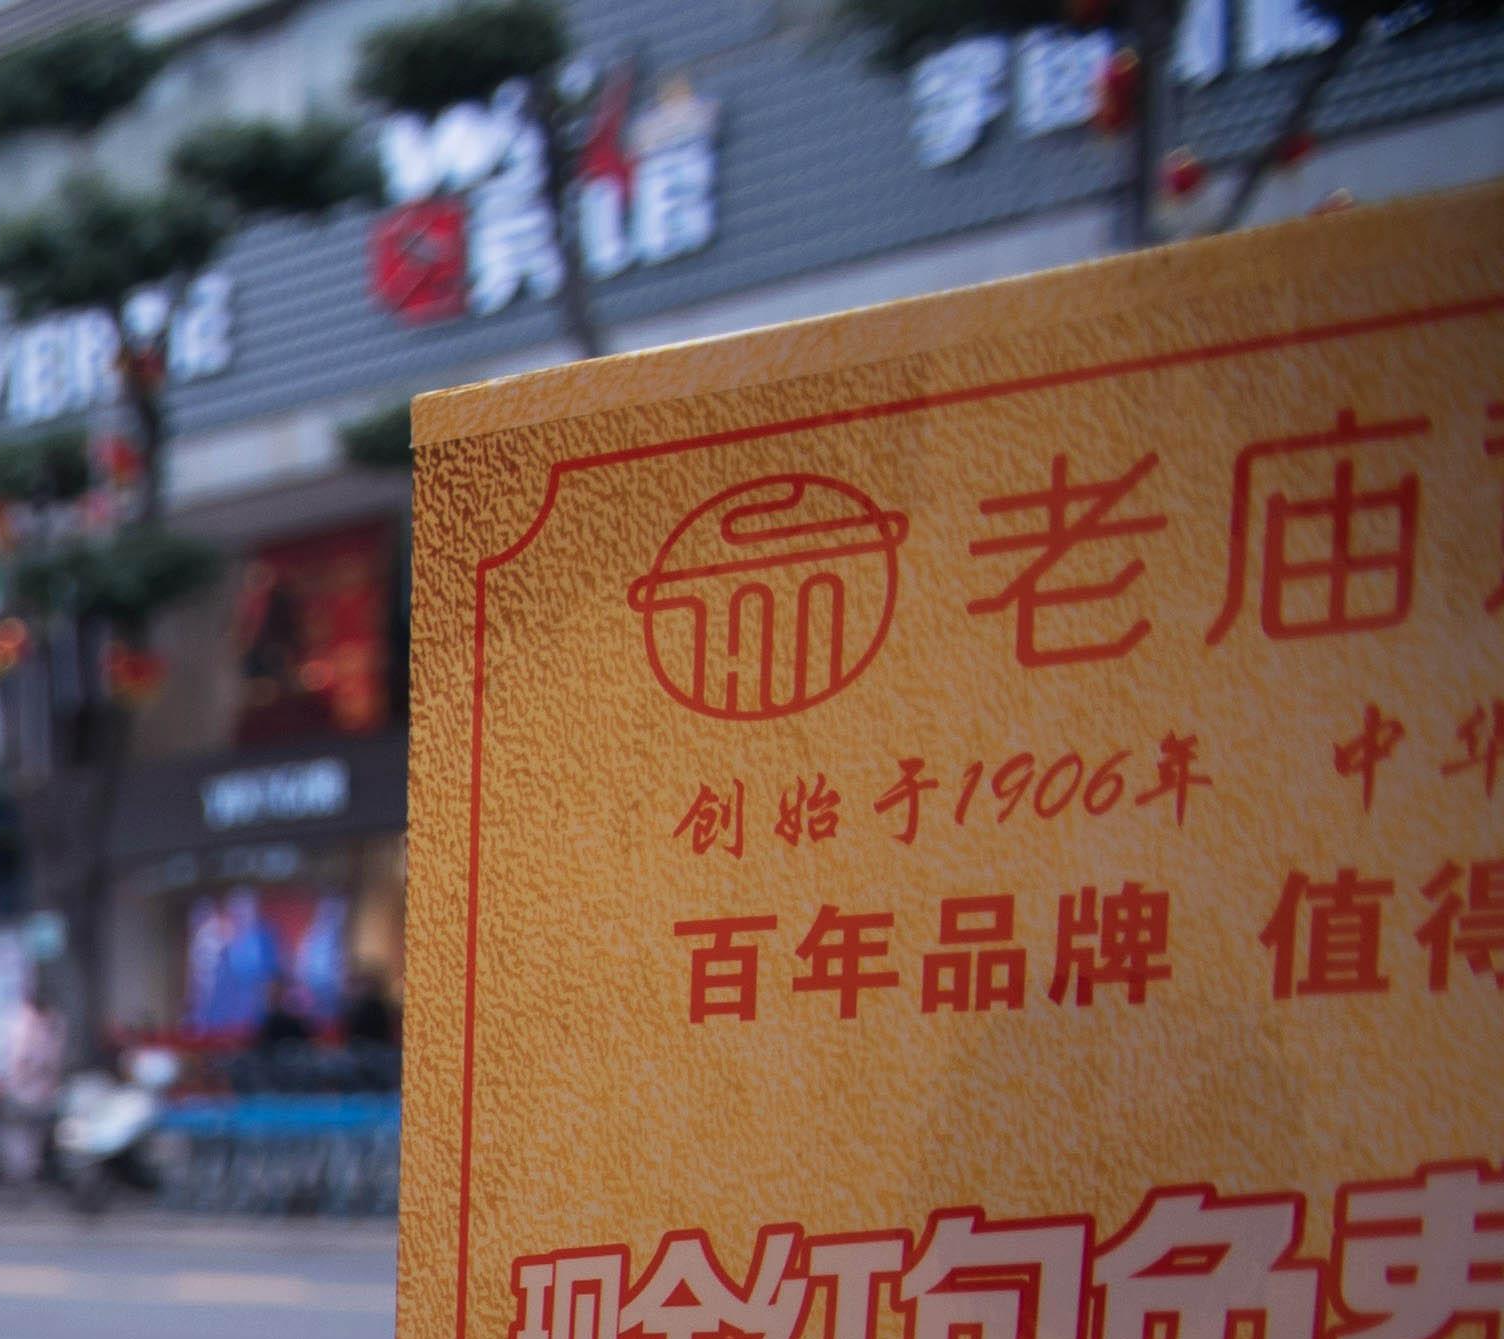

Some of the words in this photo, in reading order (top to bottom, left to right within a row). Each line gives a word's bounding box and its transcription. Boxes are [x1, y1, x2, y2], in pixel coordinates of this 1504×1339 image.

[966, 400, 1504, 668] 老庙
[673, 727, 1215, 859] 创始于1906年
[674, 879, 1173, 1024] 百年品牌
[1259, 858, 1504, 1001] 值得
